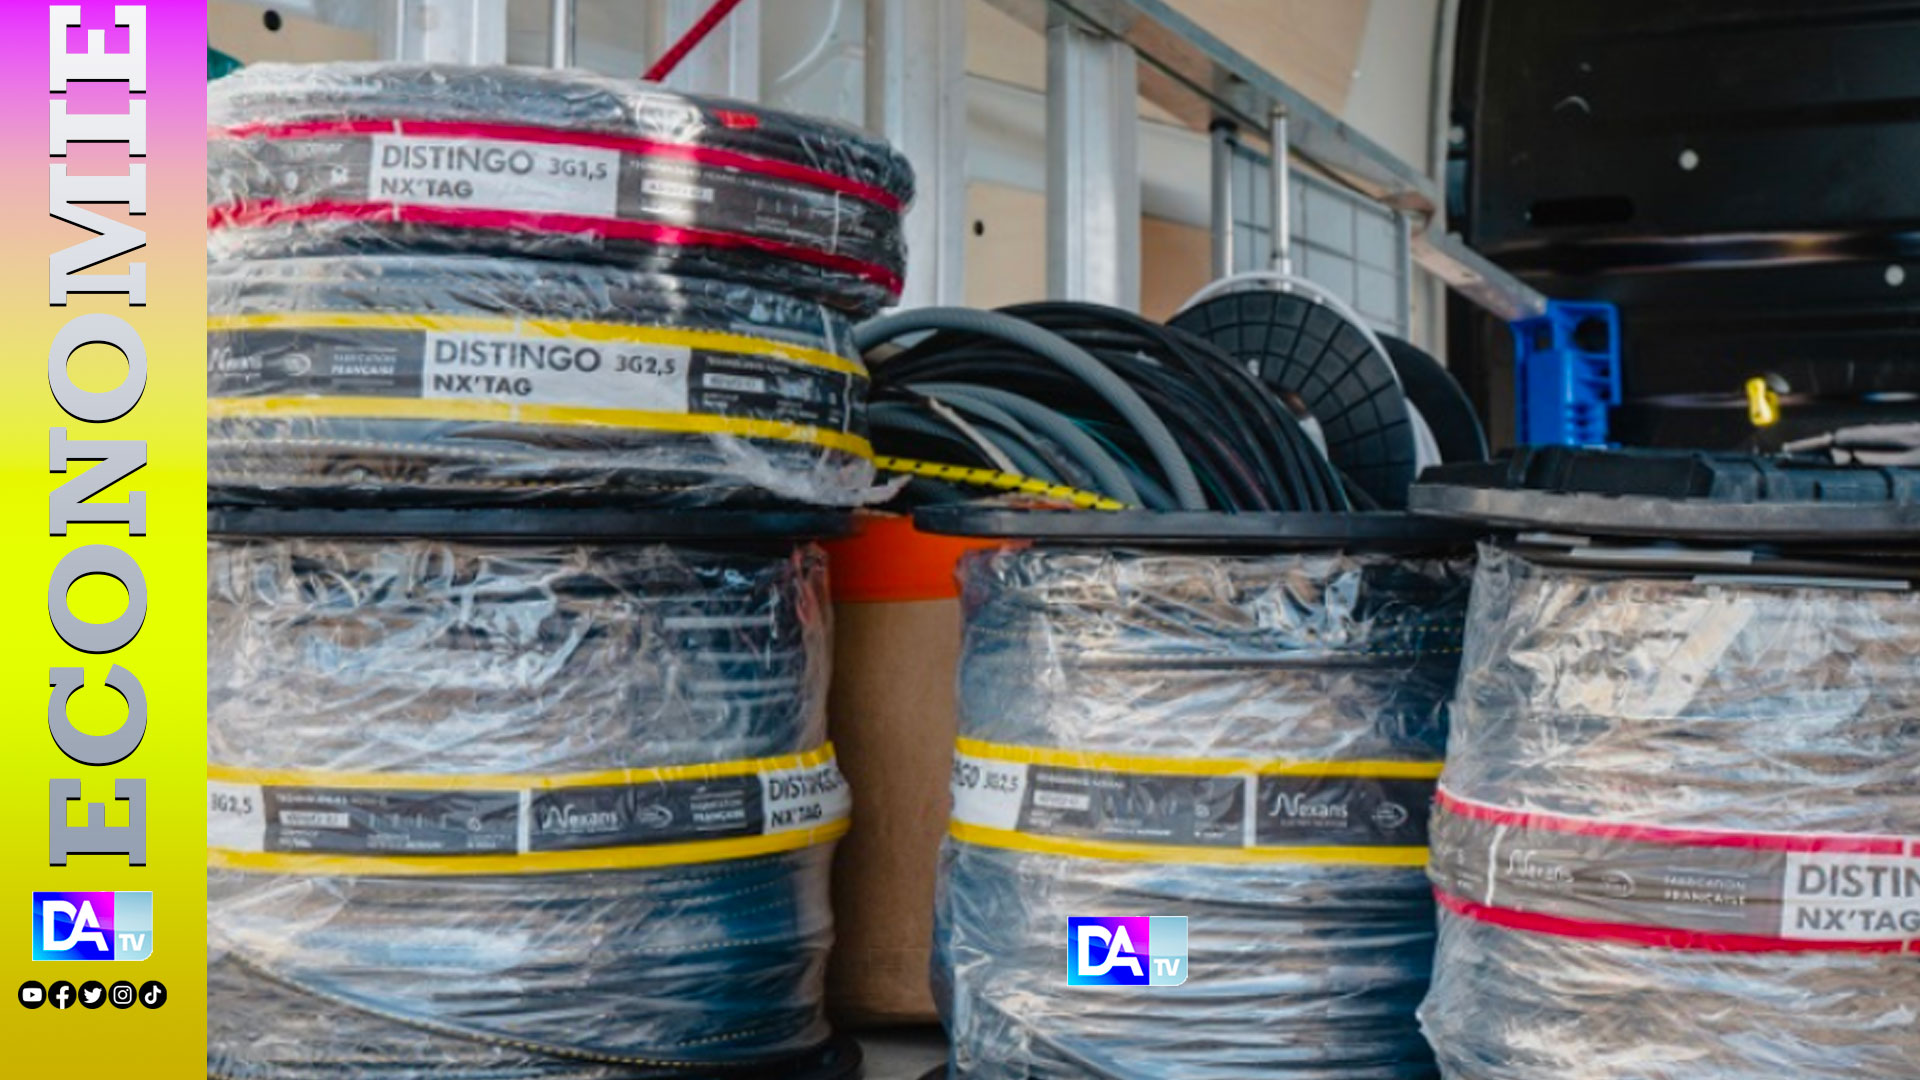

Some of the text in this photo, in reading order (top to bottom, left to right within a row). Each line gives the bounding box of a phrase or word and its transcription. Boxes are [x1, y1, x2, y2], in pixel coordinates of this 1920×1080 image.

[380, 144, 534, 175] DISTINGO
[548, 157, 608, 181] 3G1,5
[380, 178, 474, 198] NX'TAG
[434, 340, 601, 372] DISTINGO
[615, 354, 676, 377] 3G2,5
[433, 374, 533, 396] NX'TAG
[542, 804, 618, 829] Nexans
[1269, 792, 1348, 818] Nexans
